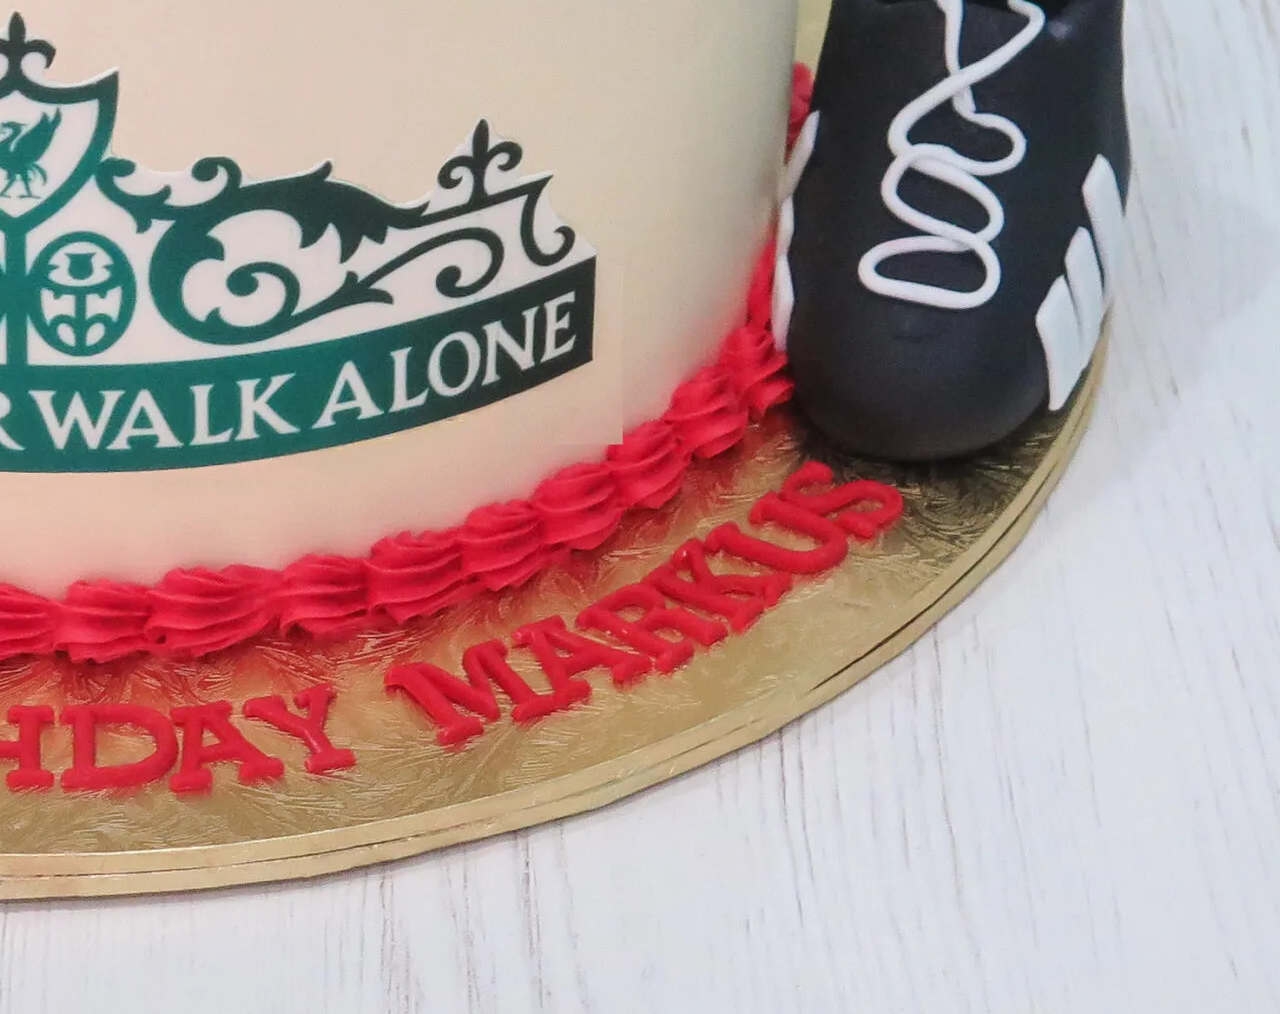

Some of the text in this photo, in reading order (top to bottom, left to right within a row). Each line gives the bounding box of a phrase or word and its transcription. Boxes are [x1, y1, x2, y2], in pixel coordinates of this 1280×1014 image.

[28, 372, 299, 451] WALK
[312, 289, 577, 432] ALONE
[383, 460, 904, 746] MARKUS
